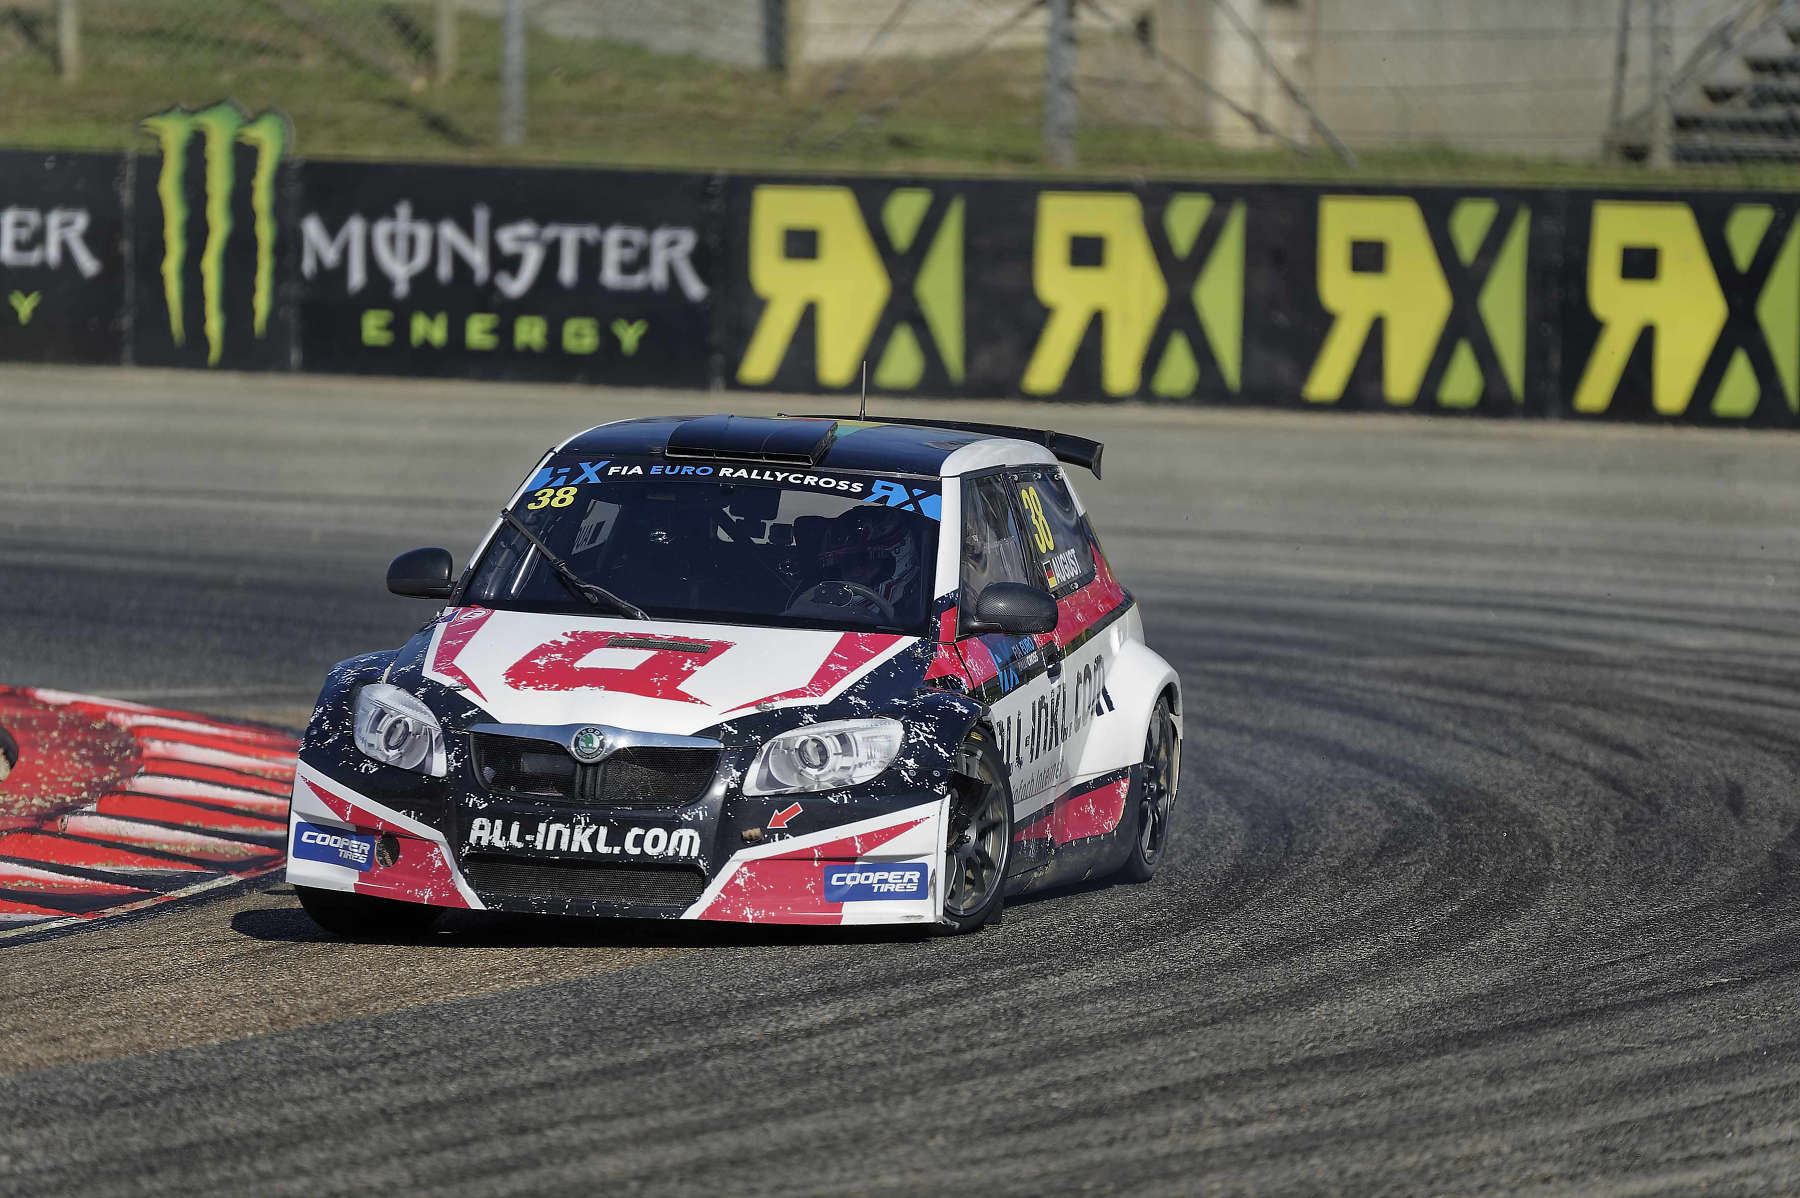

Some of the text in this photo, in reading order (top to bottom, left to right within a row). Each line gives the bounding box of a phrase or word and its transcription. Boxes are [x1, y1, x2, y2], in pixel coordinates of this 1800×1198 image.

[302, 202, 706, 299] MONSTER
[361, 310, 648, 356] ENERGY
[608, 465, 864, 493] FIA EURO RALLYCROSS
[527, 487, 578, 510] 38
[1021, 486, 1055, 554] 38
[1052, 548, 1082, 584] AUGUST
[301, 830, 371, 853] COOPER
[338, 850, 367, 863] TIRES
[831, 872, 920, 886] COOPER
[872, 883, 918, 892] TIRES
